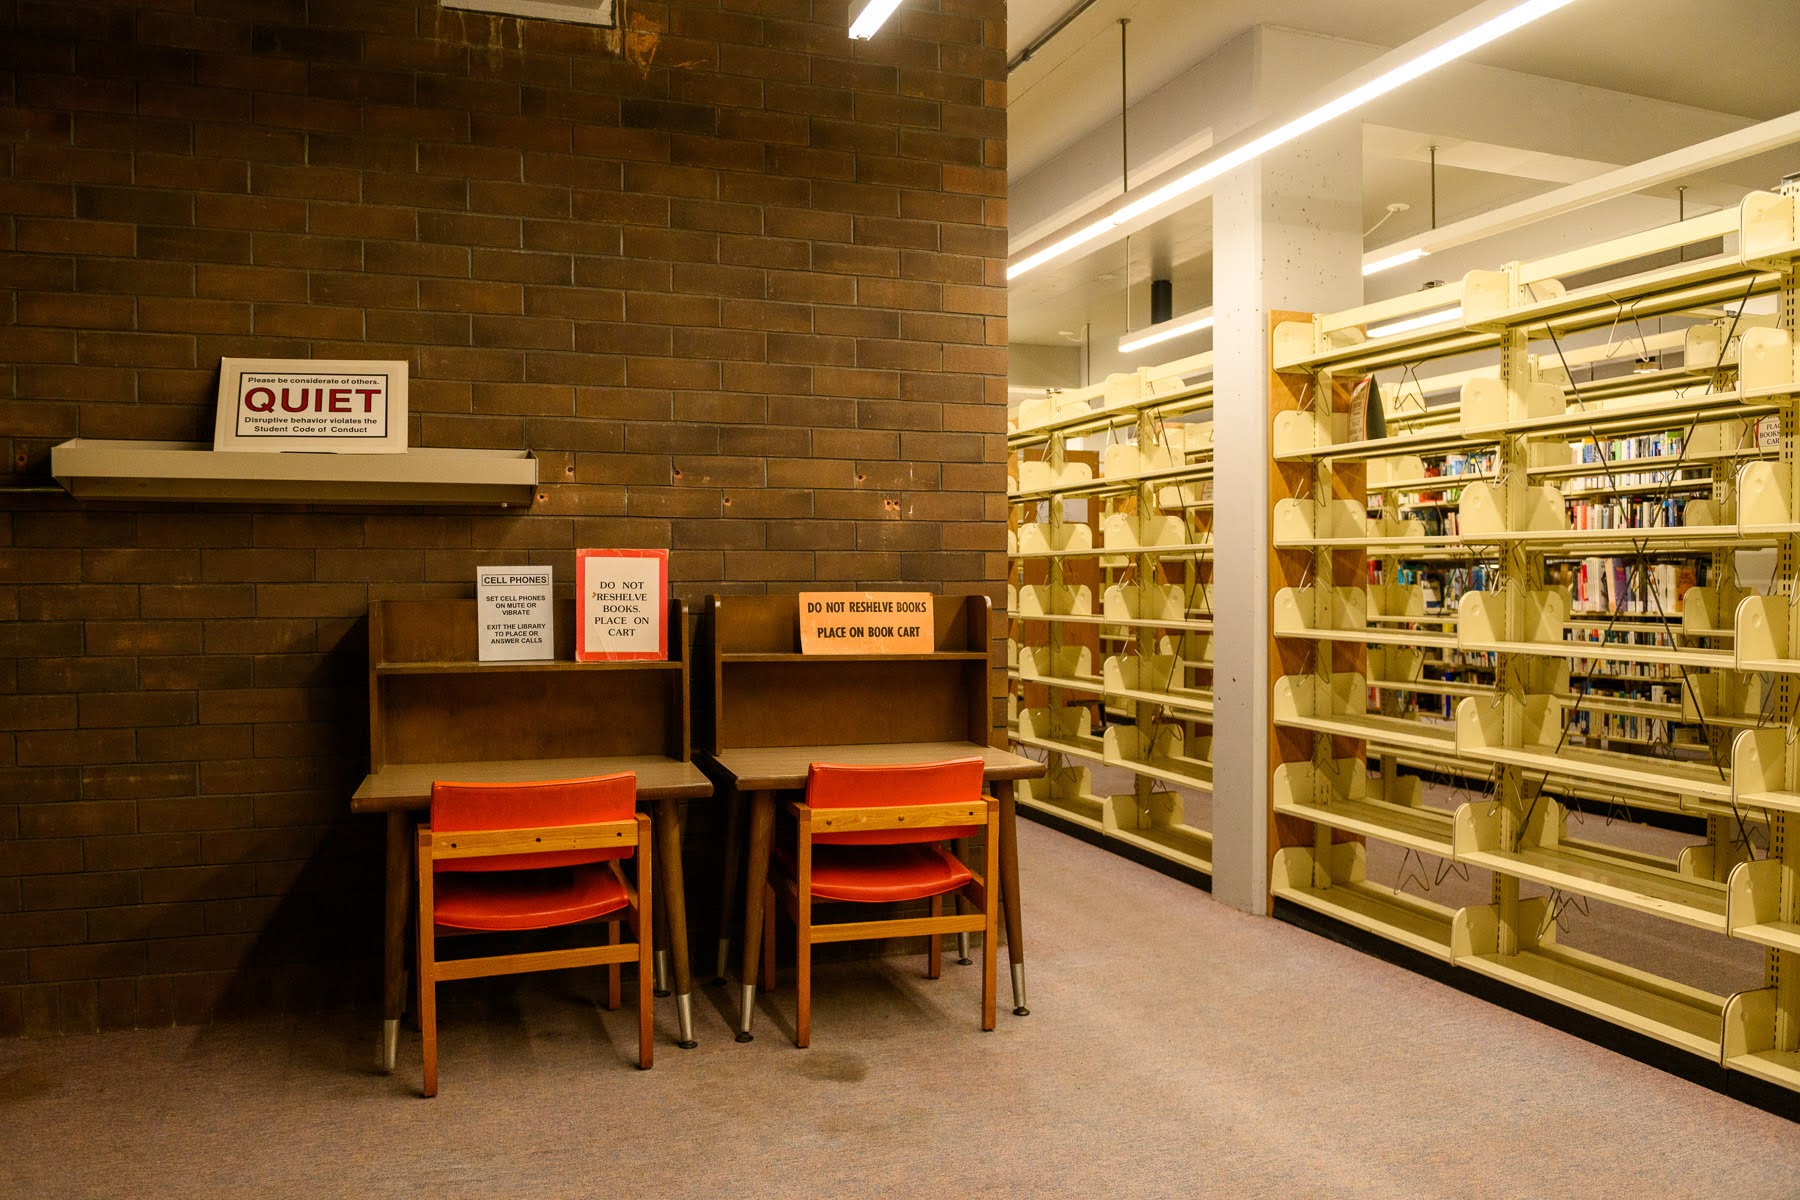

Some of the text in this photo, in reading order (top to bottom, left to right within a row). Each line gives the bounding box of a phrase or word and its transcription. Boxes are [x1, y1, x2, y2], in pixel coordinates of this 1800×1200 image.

[247, 376, 276, 384] Please
[290, 377, 339, 385] considerate
[244, 387, 382, 414] QUIET
[244, 416, 288, 424] Disruptive
[484, 576, 508, 584] CELL
[599, 581, 644, 589] DO NOT
[596, 593, 647, 601] RESHELVE
[603, 605, 641, 613] BOOKS.
[807, 601, 927, 613] DO NOT RESHELVE BOOKS
[594, 617, 649, 625] PLACE ON
[608, 628, 635, 636] CART
[817, 626, 920, 638] PLACE ON BOOK CART
